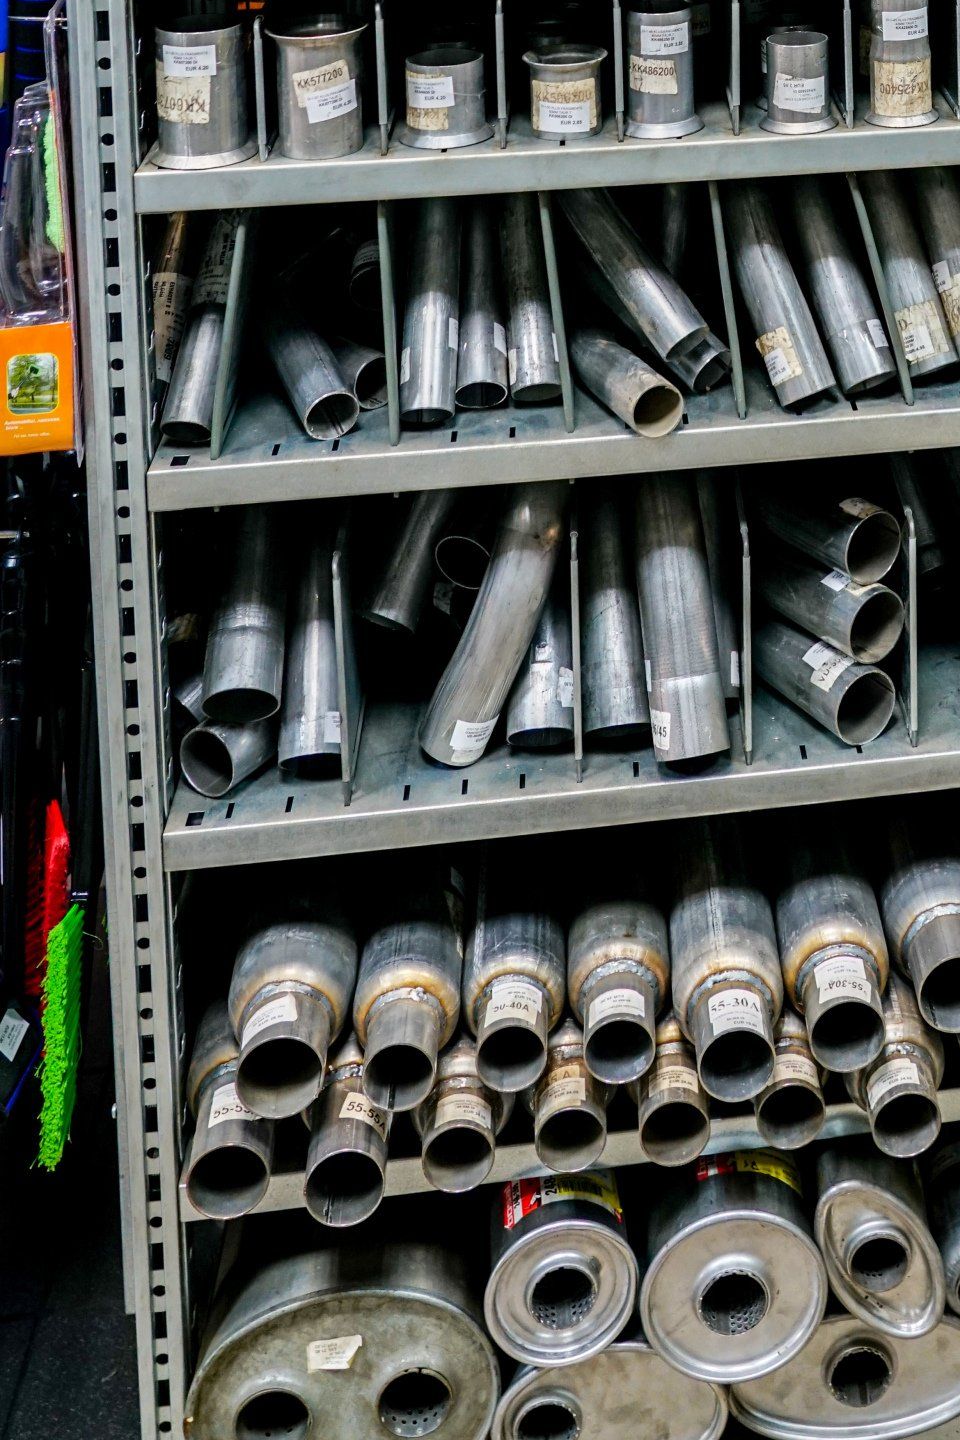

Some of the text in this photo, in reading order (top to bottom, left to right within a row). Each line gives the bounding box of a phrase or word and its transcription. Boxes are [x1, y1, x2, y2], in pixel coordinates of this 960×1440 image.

[297, 68, 343, 89] KK577200
[632, 64, 674, 76] KK486200
[346, 1100, 387, 1132] 55-55A
